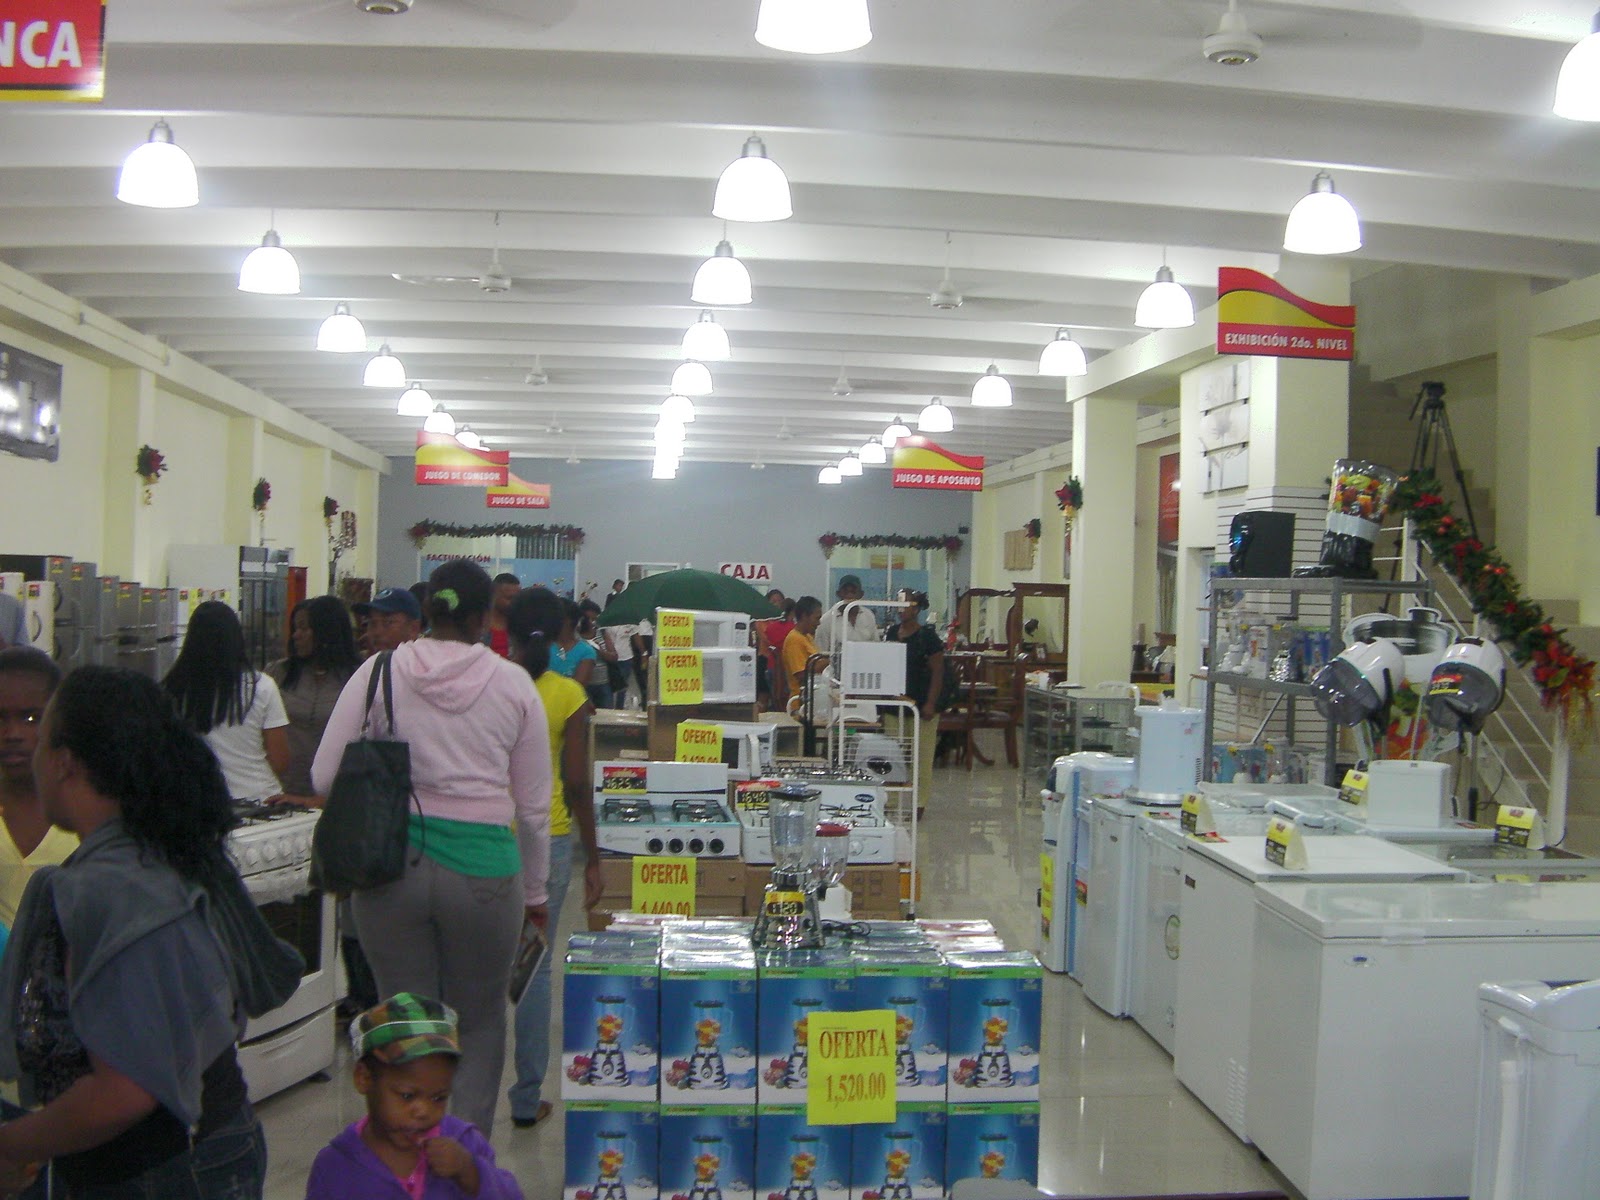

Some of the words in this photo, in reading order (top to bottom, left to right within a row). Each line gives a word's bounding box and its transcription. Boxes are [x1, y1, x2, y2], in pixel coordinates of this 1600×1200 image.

[1225, 332, 1288, 347] EXHIBICIÓN
[1290, 336, 1314, 349] 2do.
[1316, 338, 1348, 350] NIVEL
[424, 471, 450, 480] JUEGO
[451, 471, 461, 480] DE
[463, 471, 501, 481] COMEDOR
[895, 473, 923, 483] JUEGO
[925, 475, 936, 484] DE
[937, 475, 981, 486] APOSENTO
[491, 496, 515, 505] JUEGO
[516, 496, 526, 505] DE
[527, 497, 545, 506] SALA
[720, 563, 770, 580] CAJA
[663, 615, 690, 627] OFERTA
[665, 654, 698, 668] OFERTA
[683, 728, 718, 745] OFERTA
[641, 863, 689, 885] OFERTA
[819, 1028, 889, 1059] OFERTA
[826, 1072, 886, 1109] 1,520.00
